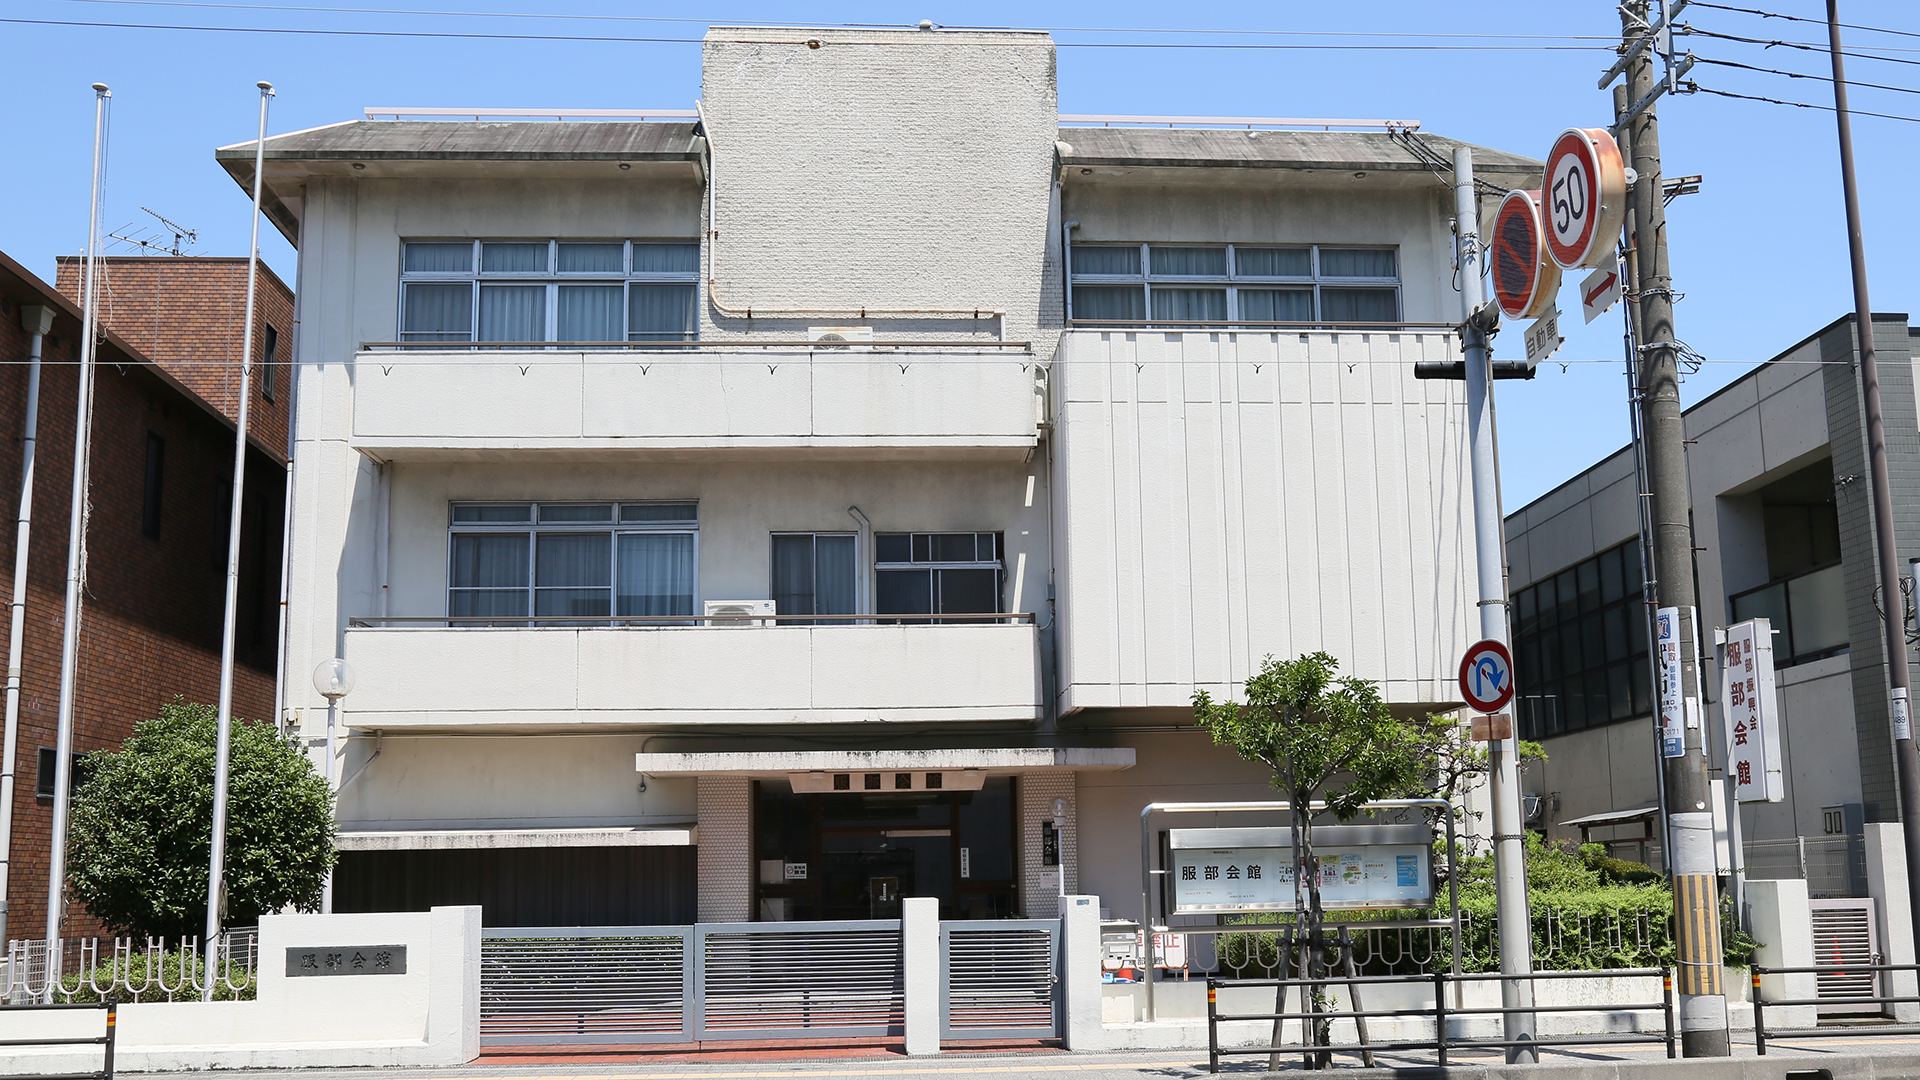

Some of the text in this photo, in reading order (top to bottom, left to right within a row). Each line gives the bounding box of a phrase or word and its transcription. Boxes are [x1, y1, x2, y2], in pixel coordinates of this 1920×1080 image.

[1552, 166, 1585, 234] 50
[1526, 319, 1557, 360] 自動車
[1743, 638, 1757, 731] 服部振興会
[1728, 641, 1752, 786] 服部会館
[835, 773, 942, 789] 服部会館
[1182, 865, 1262, 880] 服部会館
[301, 951, 392, 970] 服部会館
